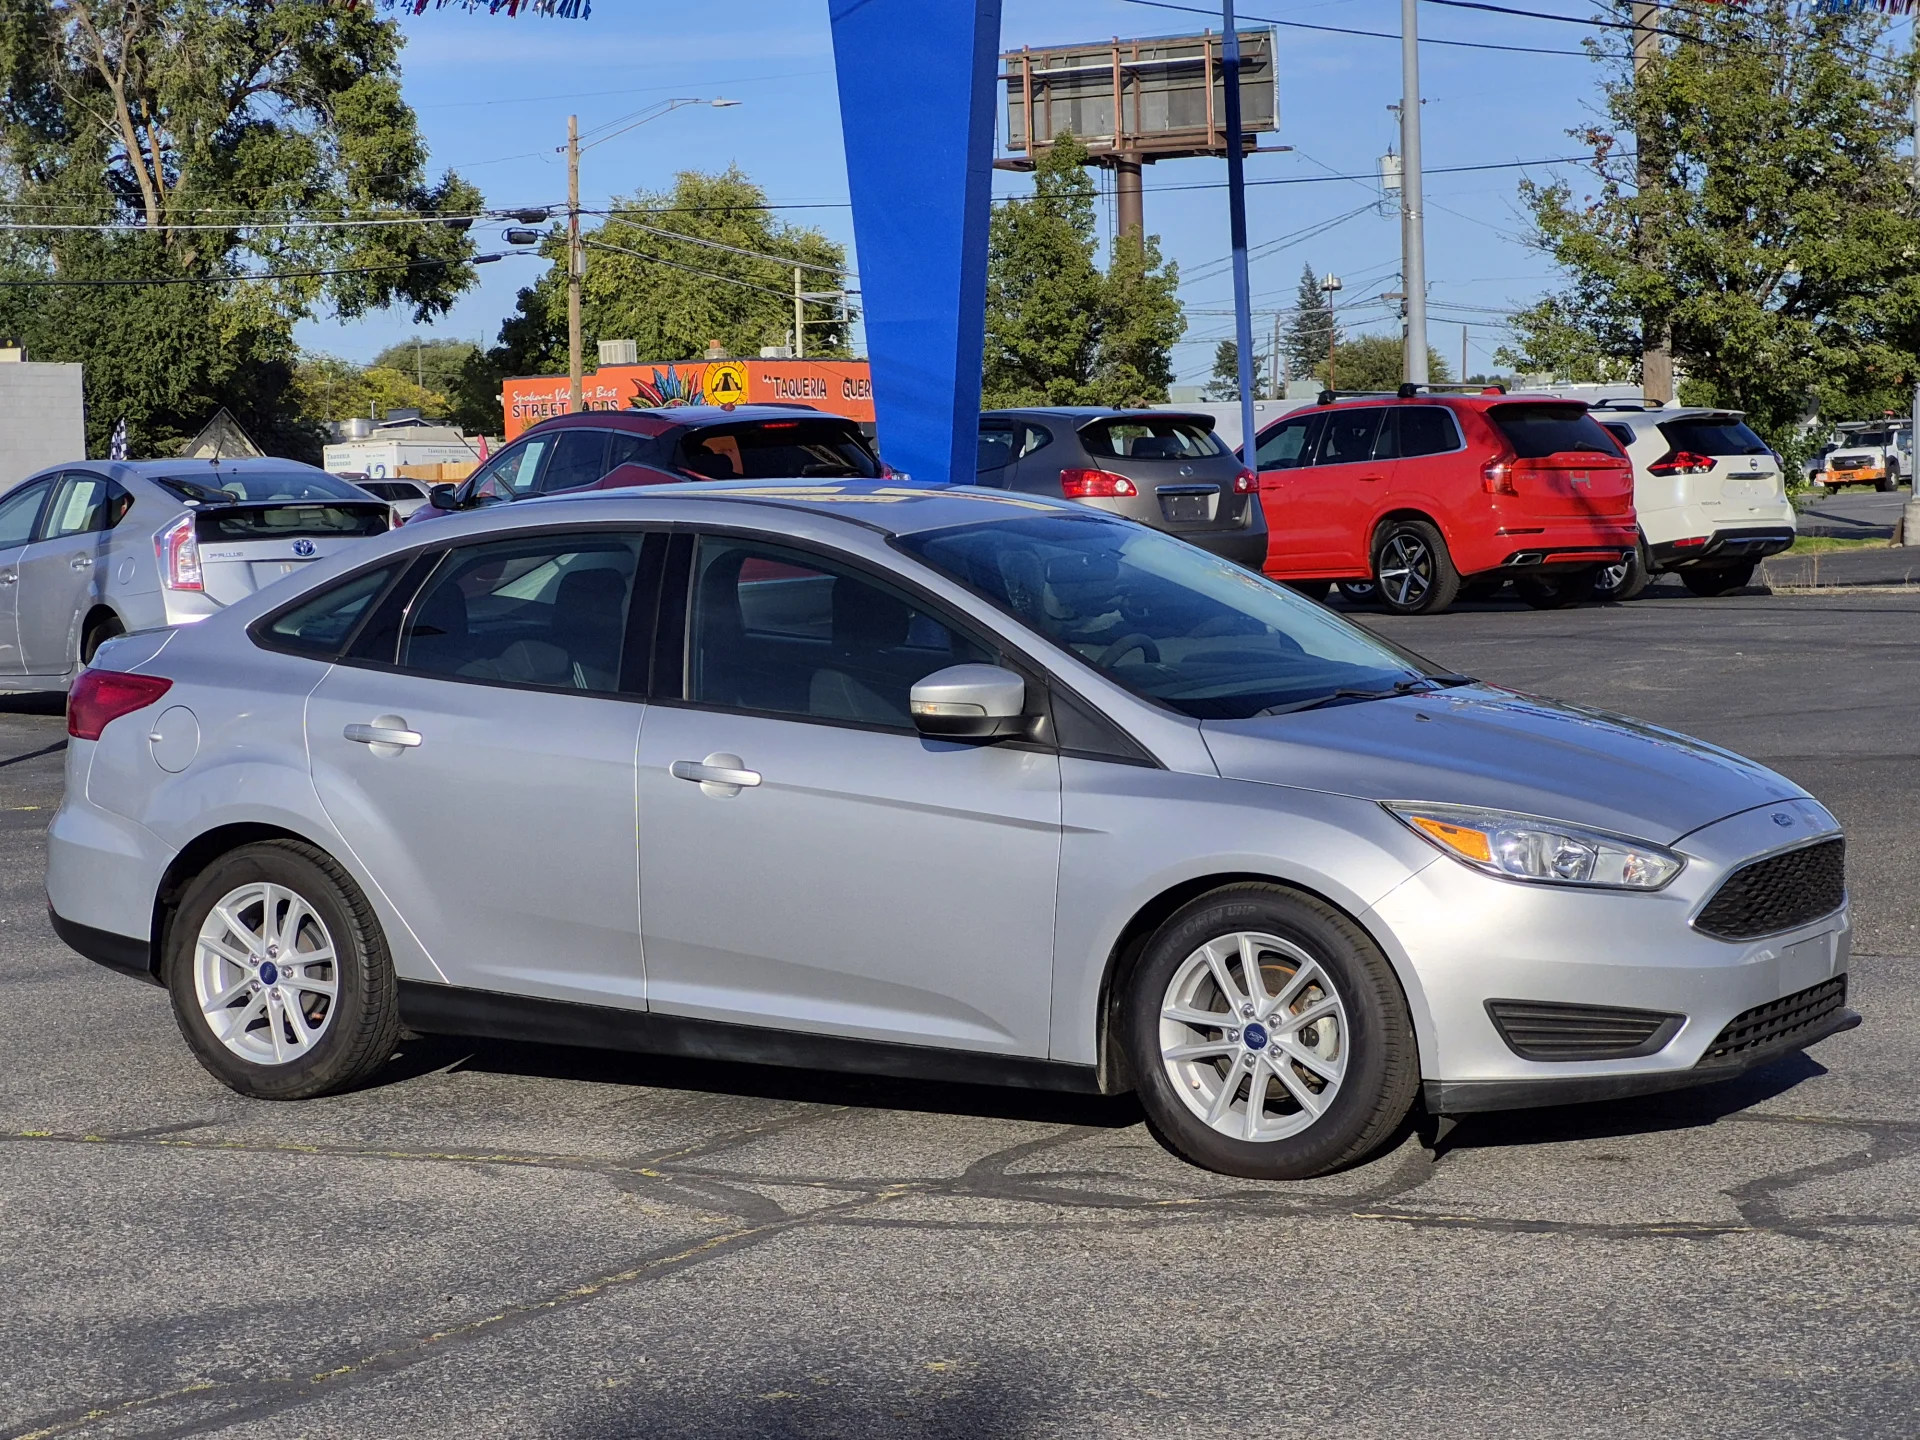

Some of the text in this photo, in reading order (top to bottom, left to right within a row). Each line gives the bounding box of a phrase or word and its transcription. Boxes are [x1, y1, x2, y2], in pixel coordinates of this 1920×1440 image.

[512, 390, 553, 404] Spokane
[595, 385, 618, 398] Best
[512, 399, 619, 418] STREET ACOS
[1227, 905, 1258, 917] UHP
